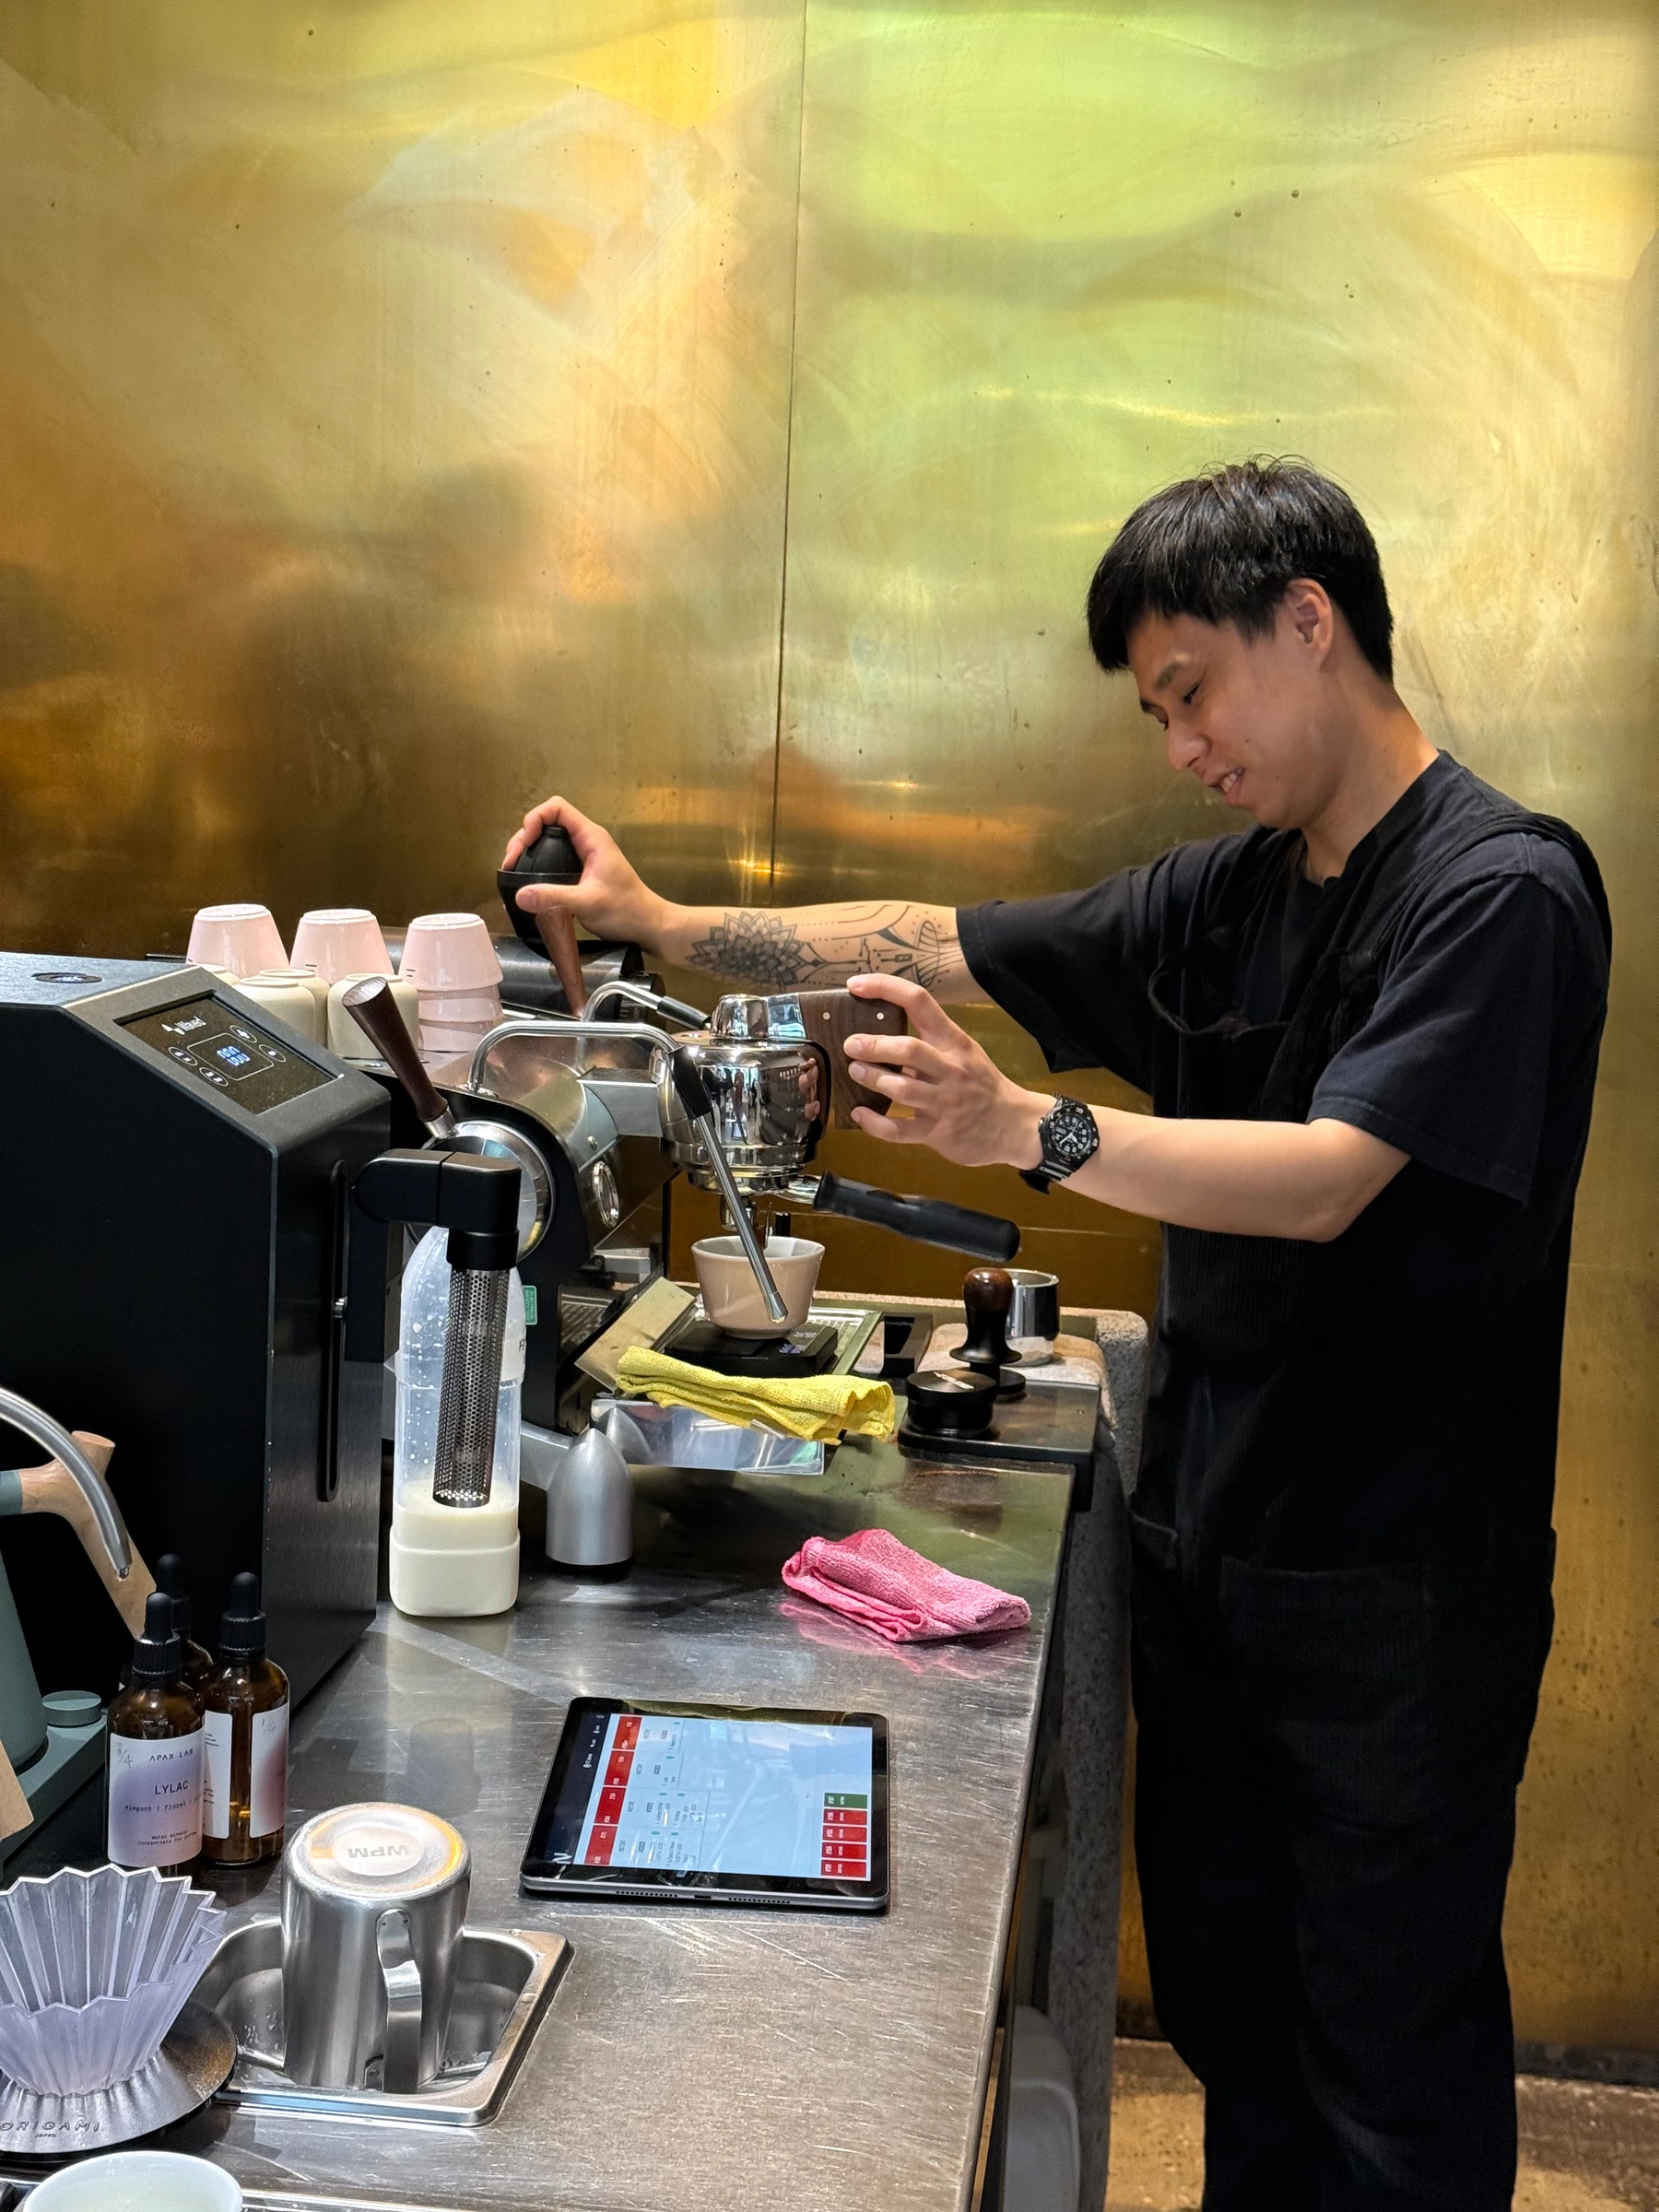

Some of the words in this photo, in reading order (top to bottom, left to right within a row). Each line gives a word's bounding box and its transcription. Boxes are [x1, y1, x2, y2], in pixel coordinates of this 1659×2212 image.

[149, 1753, 174, 1762] APAX
[179, 1748, 194, 1759] LAB
[154, 1780, 189, 1795] LYLAC
[347, 1845, 409, 1858] WPM
[0, 2120, 100, 2132] ORIGAMI
